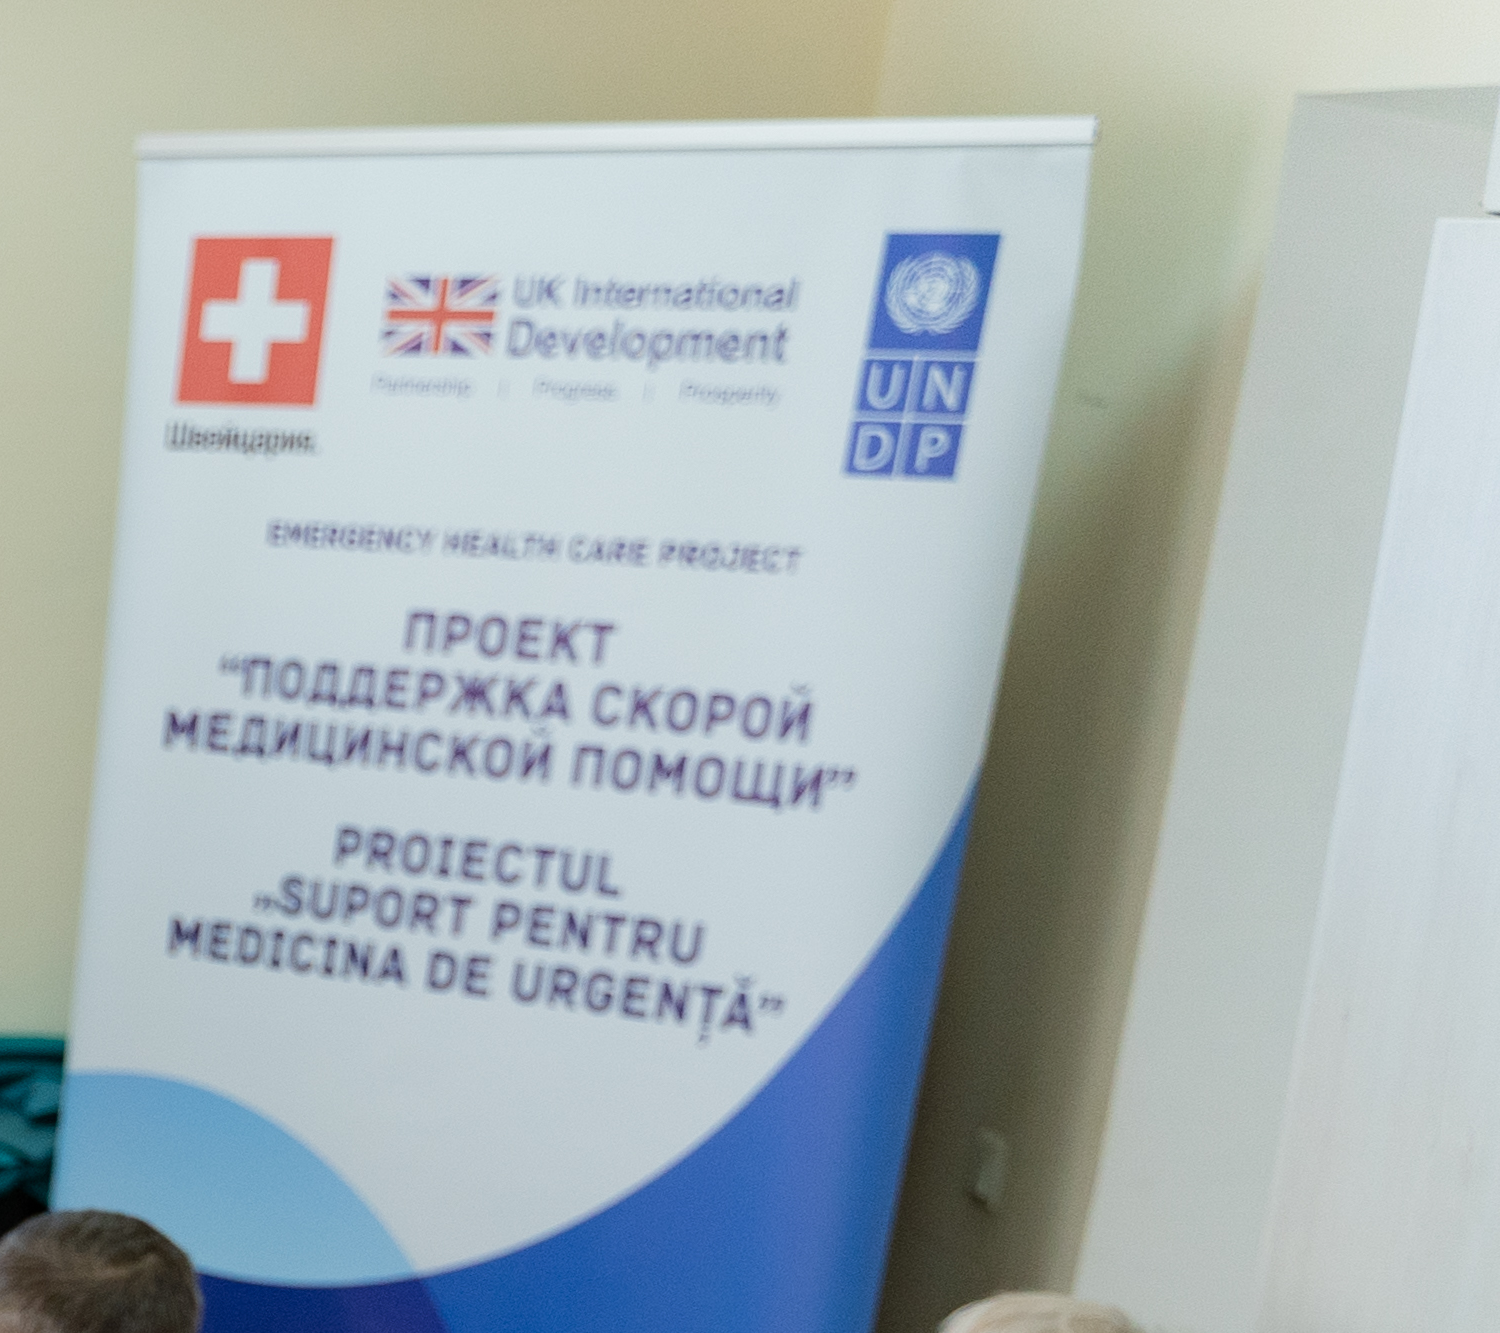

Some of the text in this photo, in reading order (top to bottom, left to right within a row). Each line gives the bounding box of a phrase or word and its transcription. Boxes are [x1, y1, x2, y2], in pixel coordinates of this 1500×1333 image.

[514, 272, 798, 309] UK International
[507, 315, 790, 372] Development
[266, 518, 802, 575] EMERGENCY HEALTH CARE PROJECT
[403, 609, 617, 667] ПРОЕКТ
[591, 682, 813, 743] СКОРОЙ
[162, 708, 553, 782] МЕДИЦИНСКОЙ
[332, 825, 621, 898] PROIECTUL
[168, 916, 404, 984] MEDICINA
[424, 951, 492, 999] DE
[491, 901, 703, 965] PENTRU
